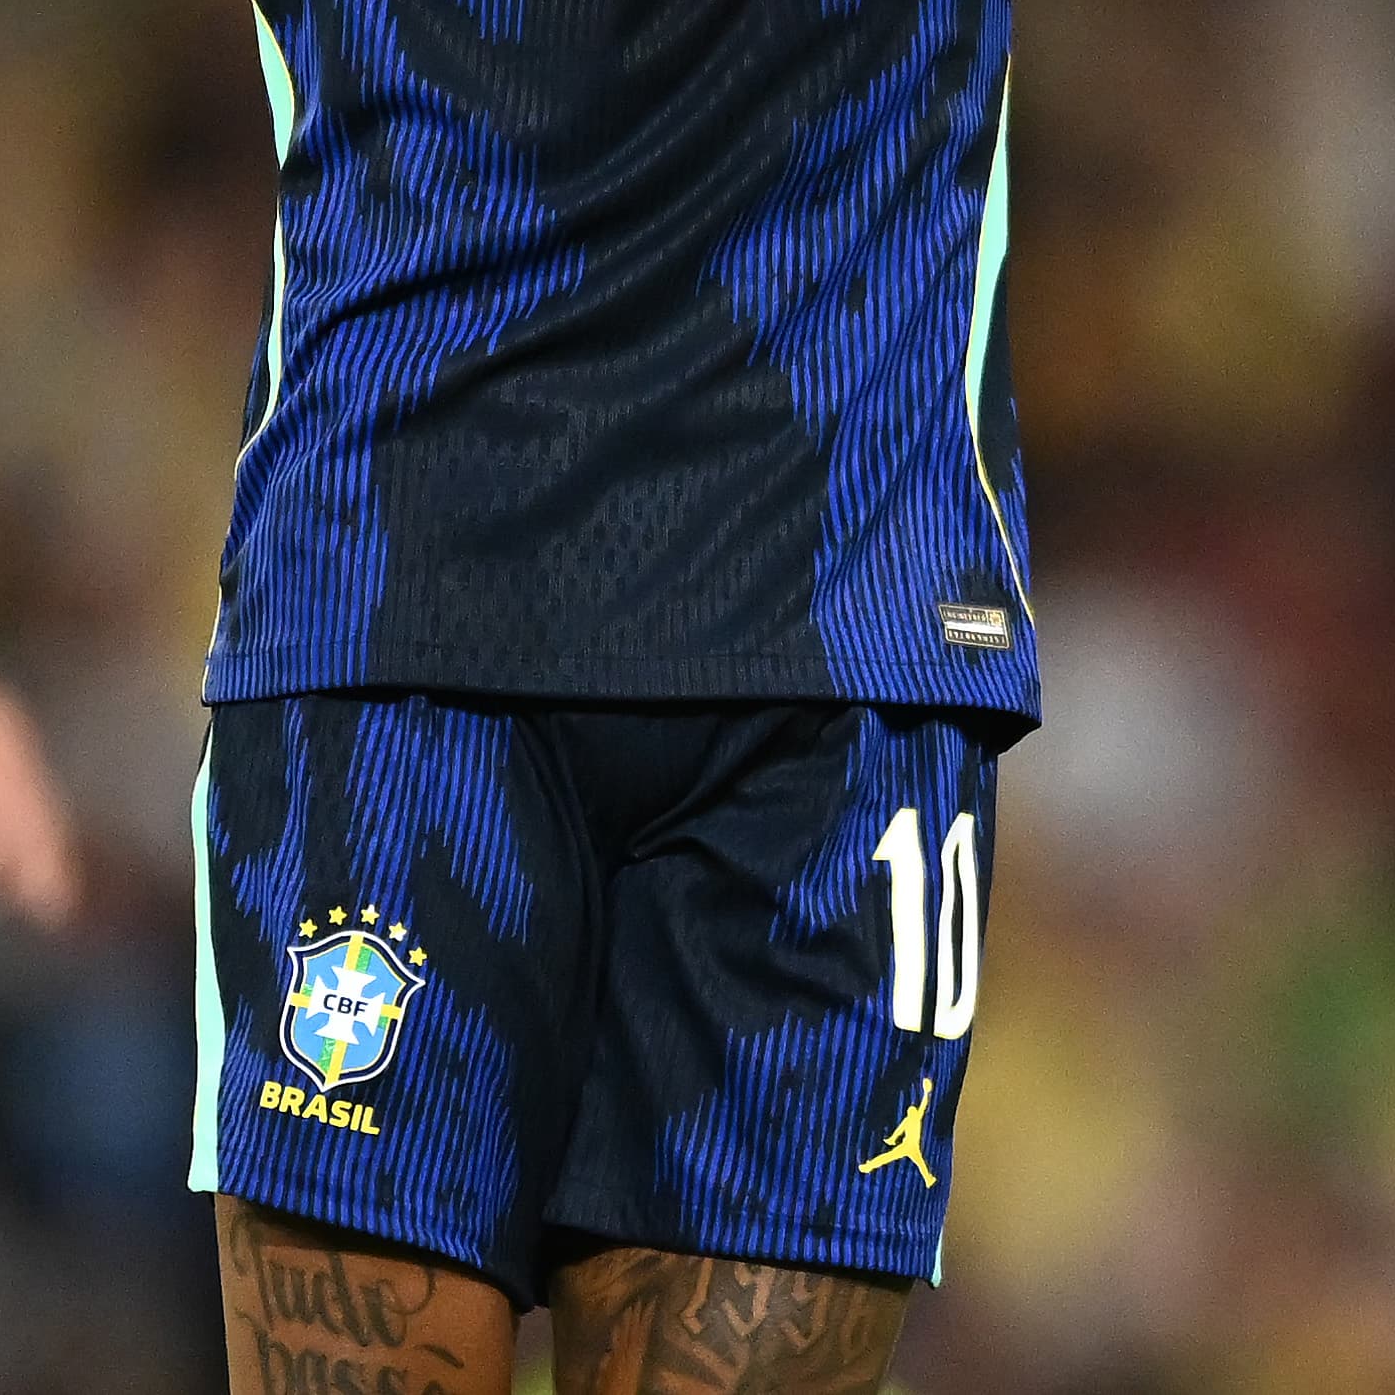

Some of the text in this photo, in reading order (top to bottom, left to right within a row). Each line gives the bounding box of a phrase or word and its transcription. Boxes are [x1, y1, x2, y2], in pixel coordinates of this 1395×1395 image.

[872, 807, 980, 1040] 10
[323, 994, 369, 1016] CBF
[259, 1080, 381, 1136] BRASIL
